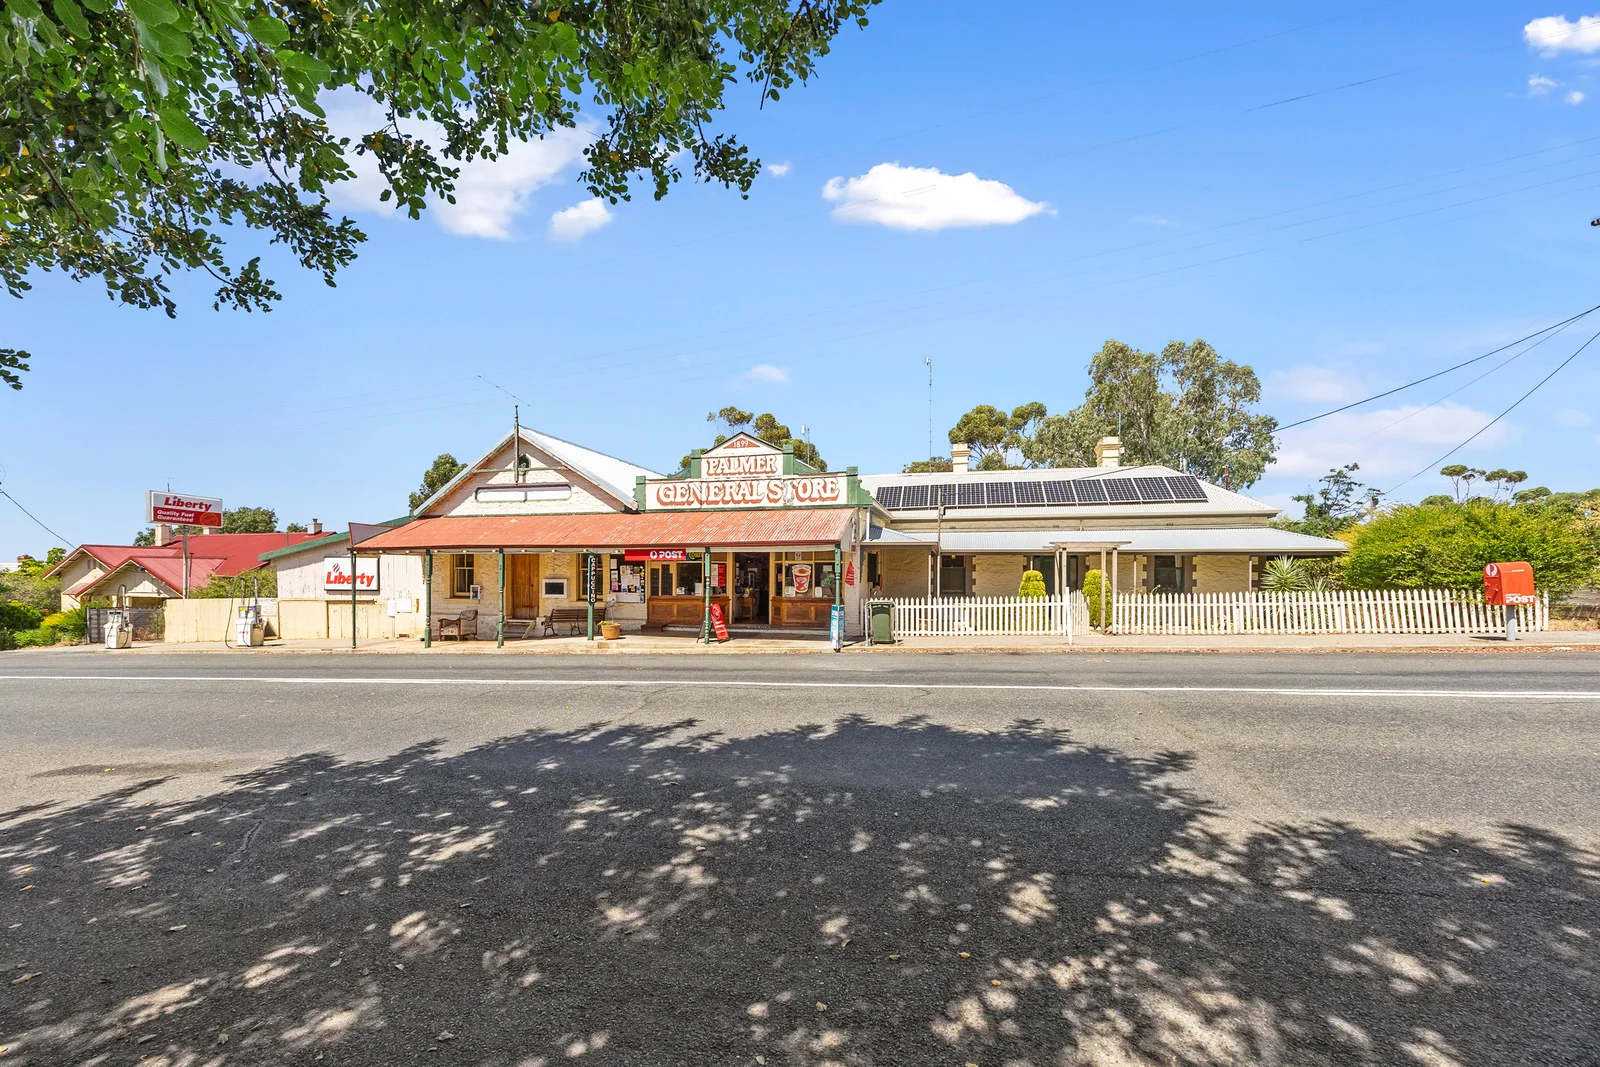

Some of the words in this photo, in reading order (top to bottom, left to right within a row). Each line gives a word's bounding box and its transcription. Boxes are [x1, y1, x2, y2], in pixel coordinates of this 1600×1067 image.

[733, 440, 749, 448] 1899
[706, 455, 777, 476] PALMER
[657, 481, 765, 506] GENERAL
[767, 477, 840, 503] STORE
[164, 496, 212, 511] Liberty
[157, 514, 194, 522] Guaranteed
[659, 551, 683, 559] POST
[325, 571, 375, 587] Liberty
[1505, 595, 1535, 603] POST
